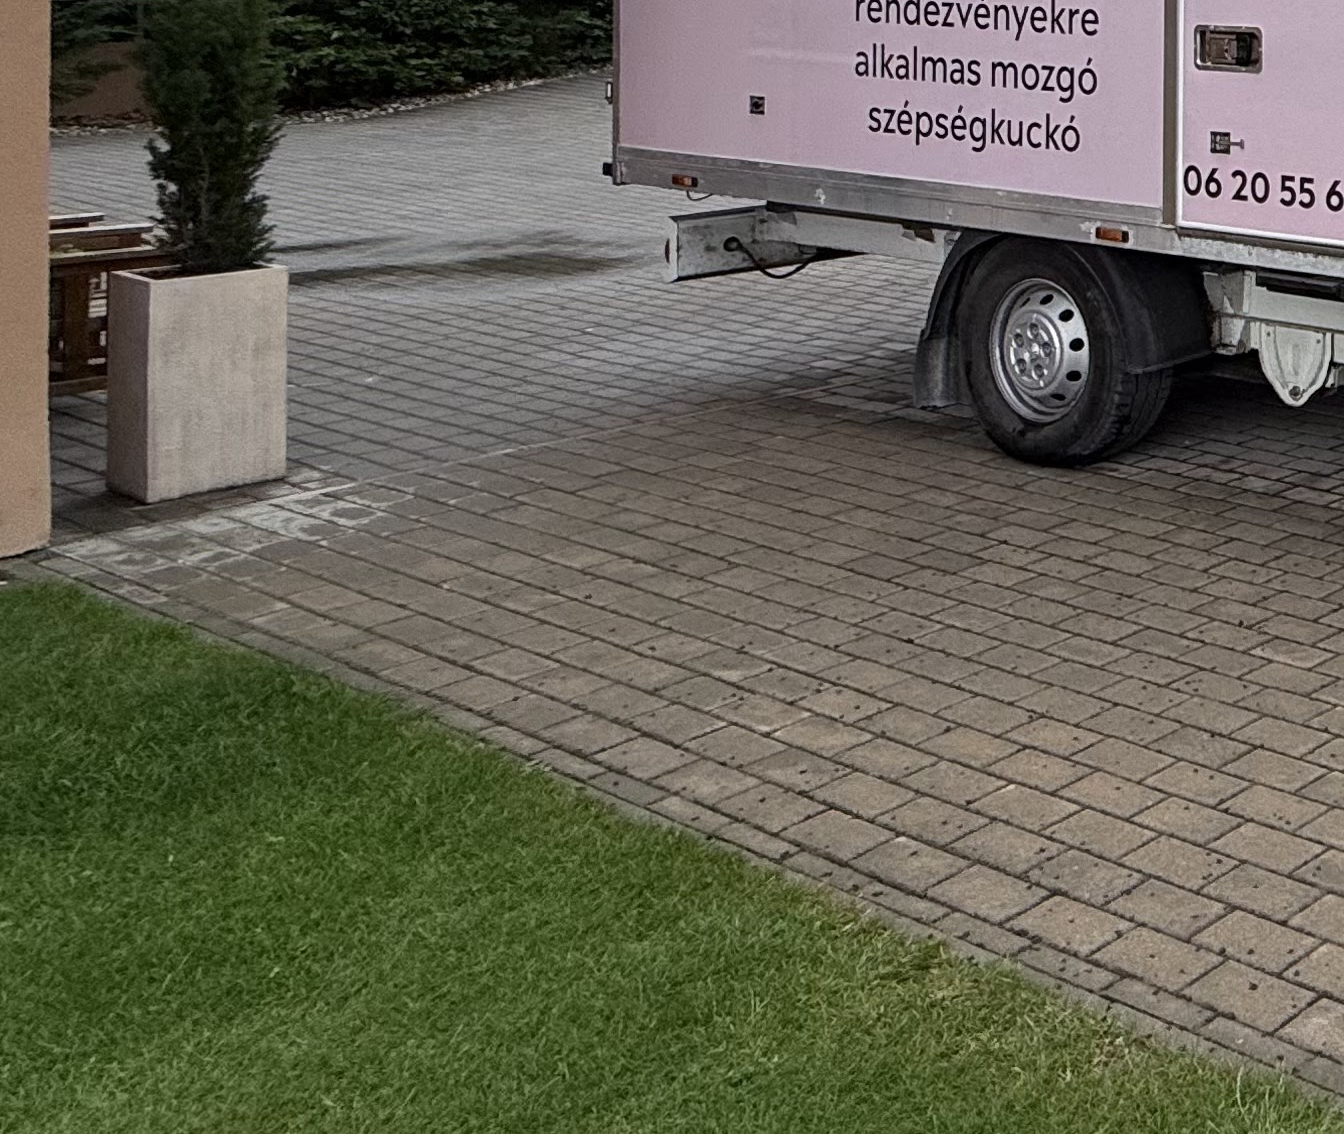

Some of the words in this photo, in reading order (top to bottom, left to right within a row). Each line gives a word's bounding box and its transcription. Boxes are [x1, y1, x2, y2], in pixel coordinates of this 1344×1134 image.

[854, 42, 982, 87] alkalmas
[990, 56, 1098, 104] mozgó
[867, 99, 1081, 153] szépségkuckó
[1182, 164, 1223, 199] 06
[1230, 169, 1271, 204] 20
[1279, 174, 1316, 210] 55
